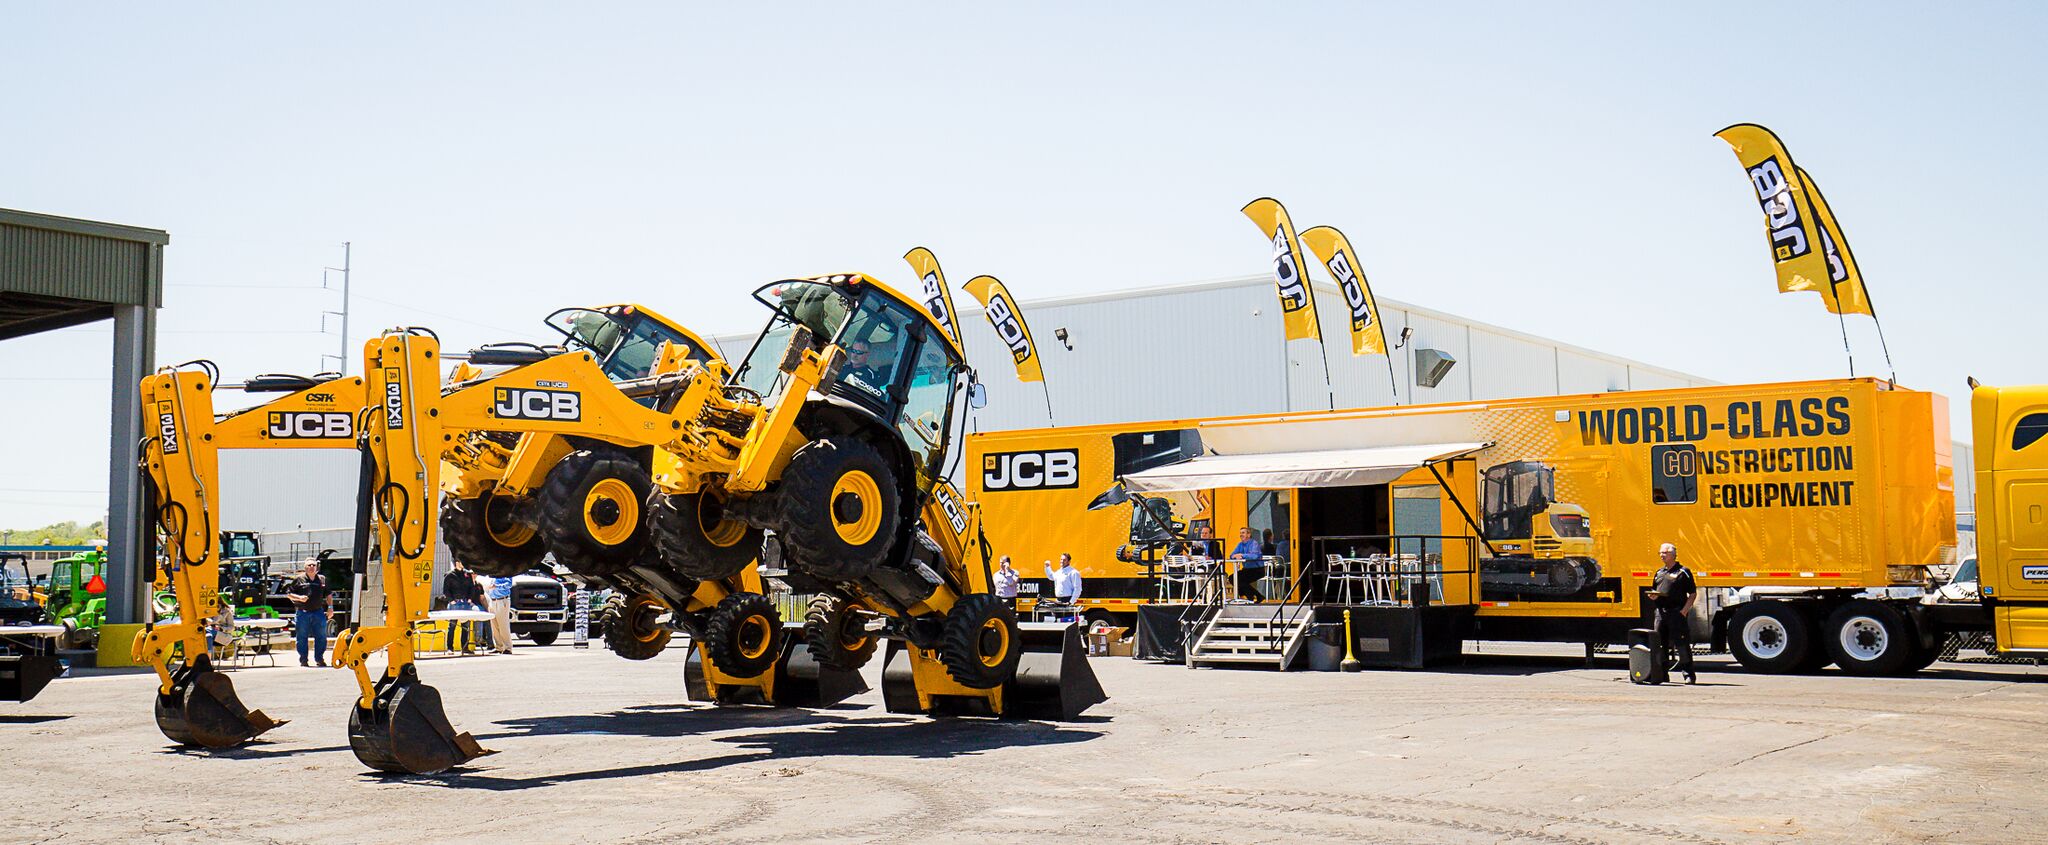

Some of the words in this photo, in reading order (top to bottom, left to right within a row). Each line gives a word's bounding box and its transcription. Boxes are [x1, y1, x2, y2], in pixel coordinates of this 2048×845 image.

[1750, 160, 1806, 255] JCB
[1328, 252, 1371, 327] JCB
[987, 295, 1031, 357] JCB
[305, 393, 333, 402] CSTK
[387, 383, 402, 420] 3CX
[496, 390, 579, 419] JCB
[160, 414, 176, 447] 3CX
[270, 413, 352, 437] JCB
[1578, 396, 1851, 446] WORLD-CLASS
[985, 452, 1077, 488] JCB
[1662, 446, 1853, 477] CONSTRUCTION
[935, 490, 966, 534] JCB
[1709, 481, 1854, 508] EQUIPMENT
